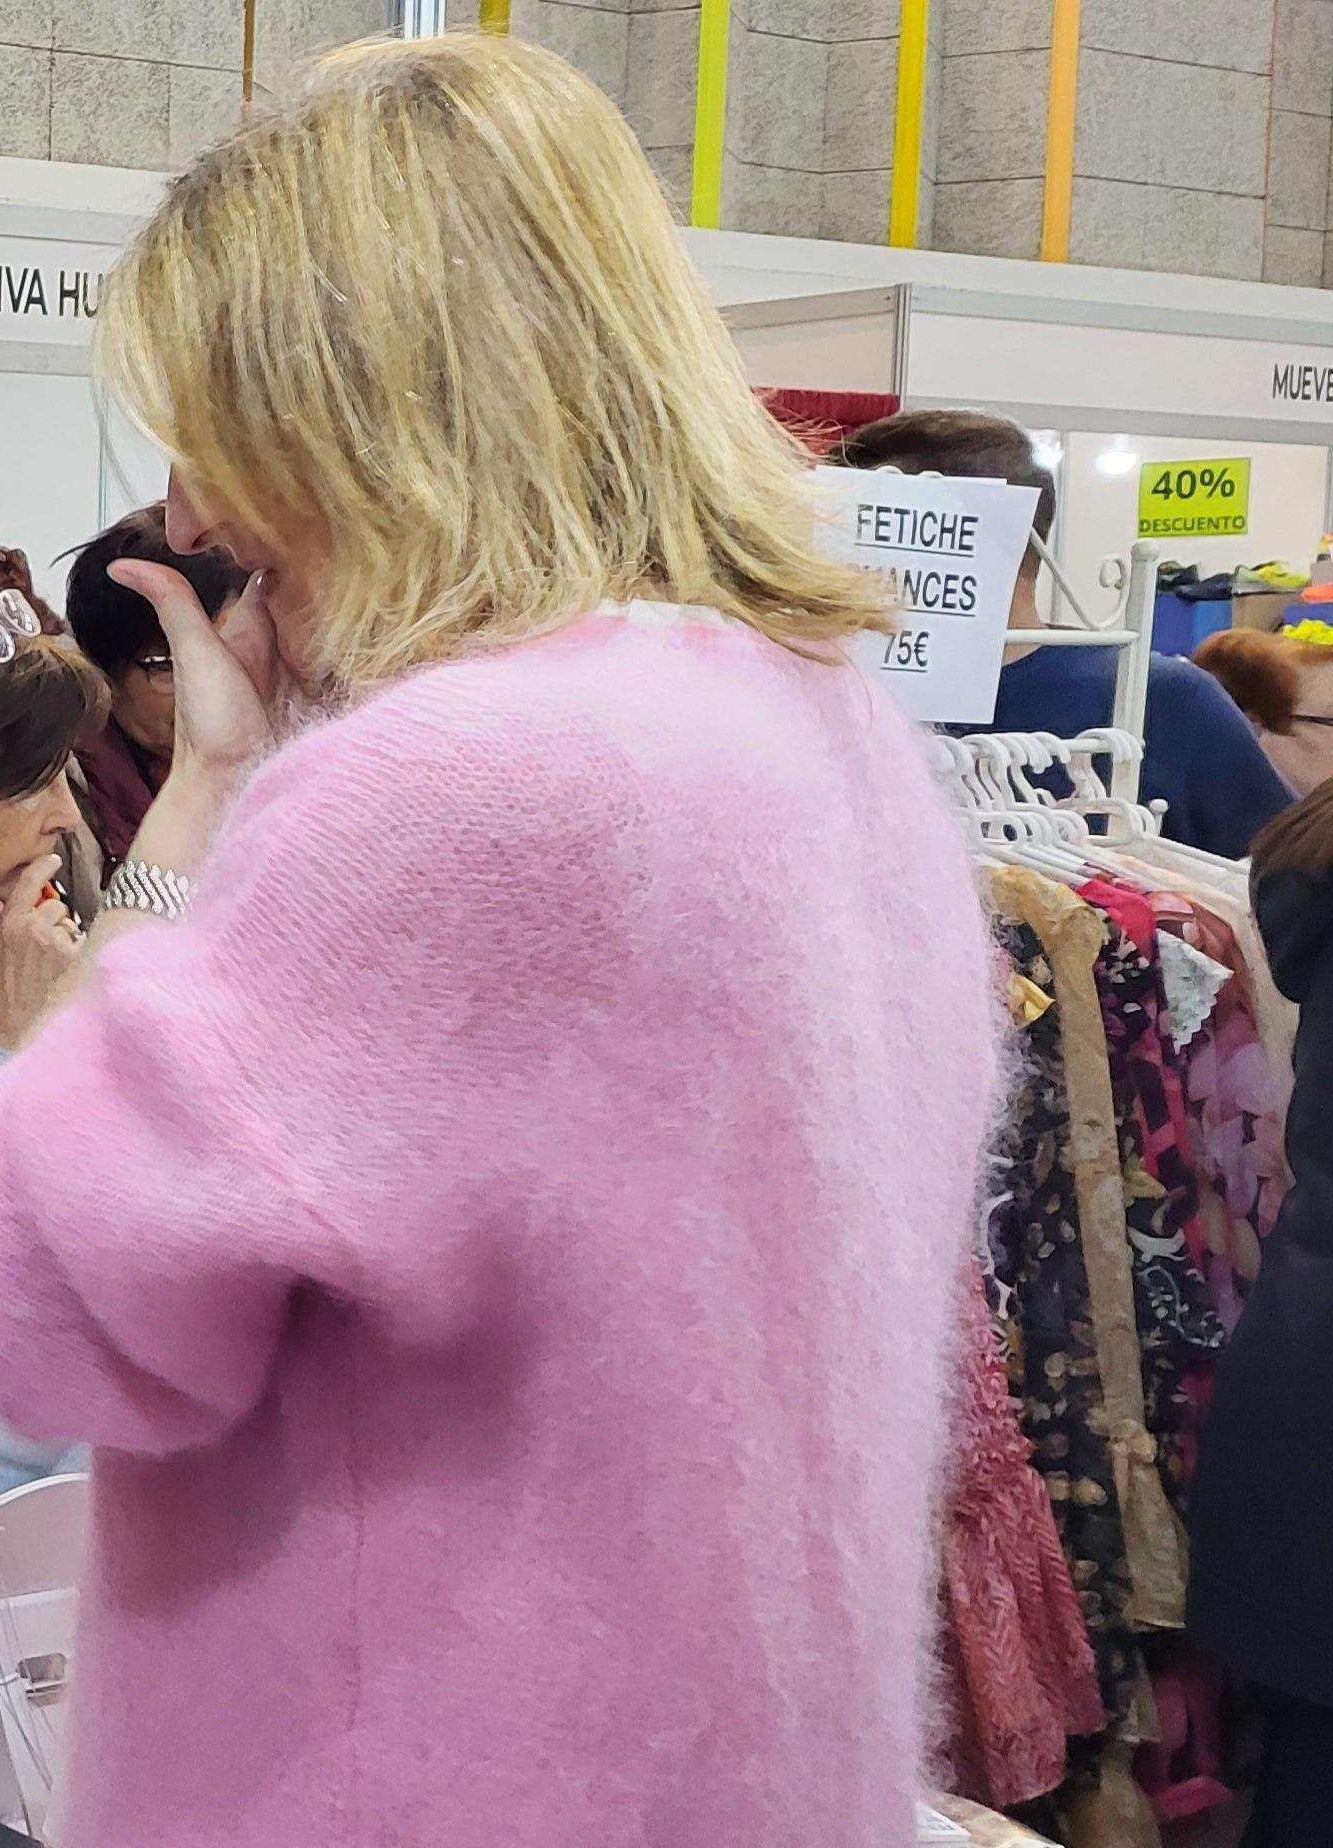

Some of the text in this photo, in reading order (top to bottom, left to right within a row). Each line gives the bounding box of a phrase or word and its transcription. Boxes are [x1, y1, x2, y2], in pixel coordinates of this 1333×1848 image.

[1272, 363, 1333, 402] MUEVE
[1151, 468, 1235, 500] 40%
[856, 504, 979, 551] FETICHE
[1139, 515, 1245, 533] DESCUENTO
